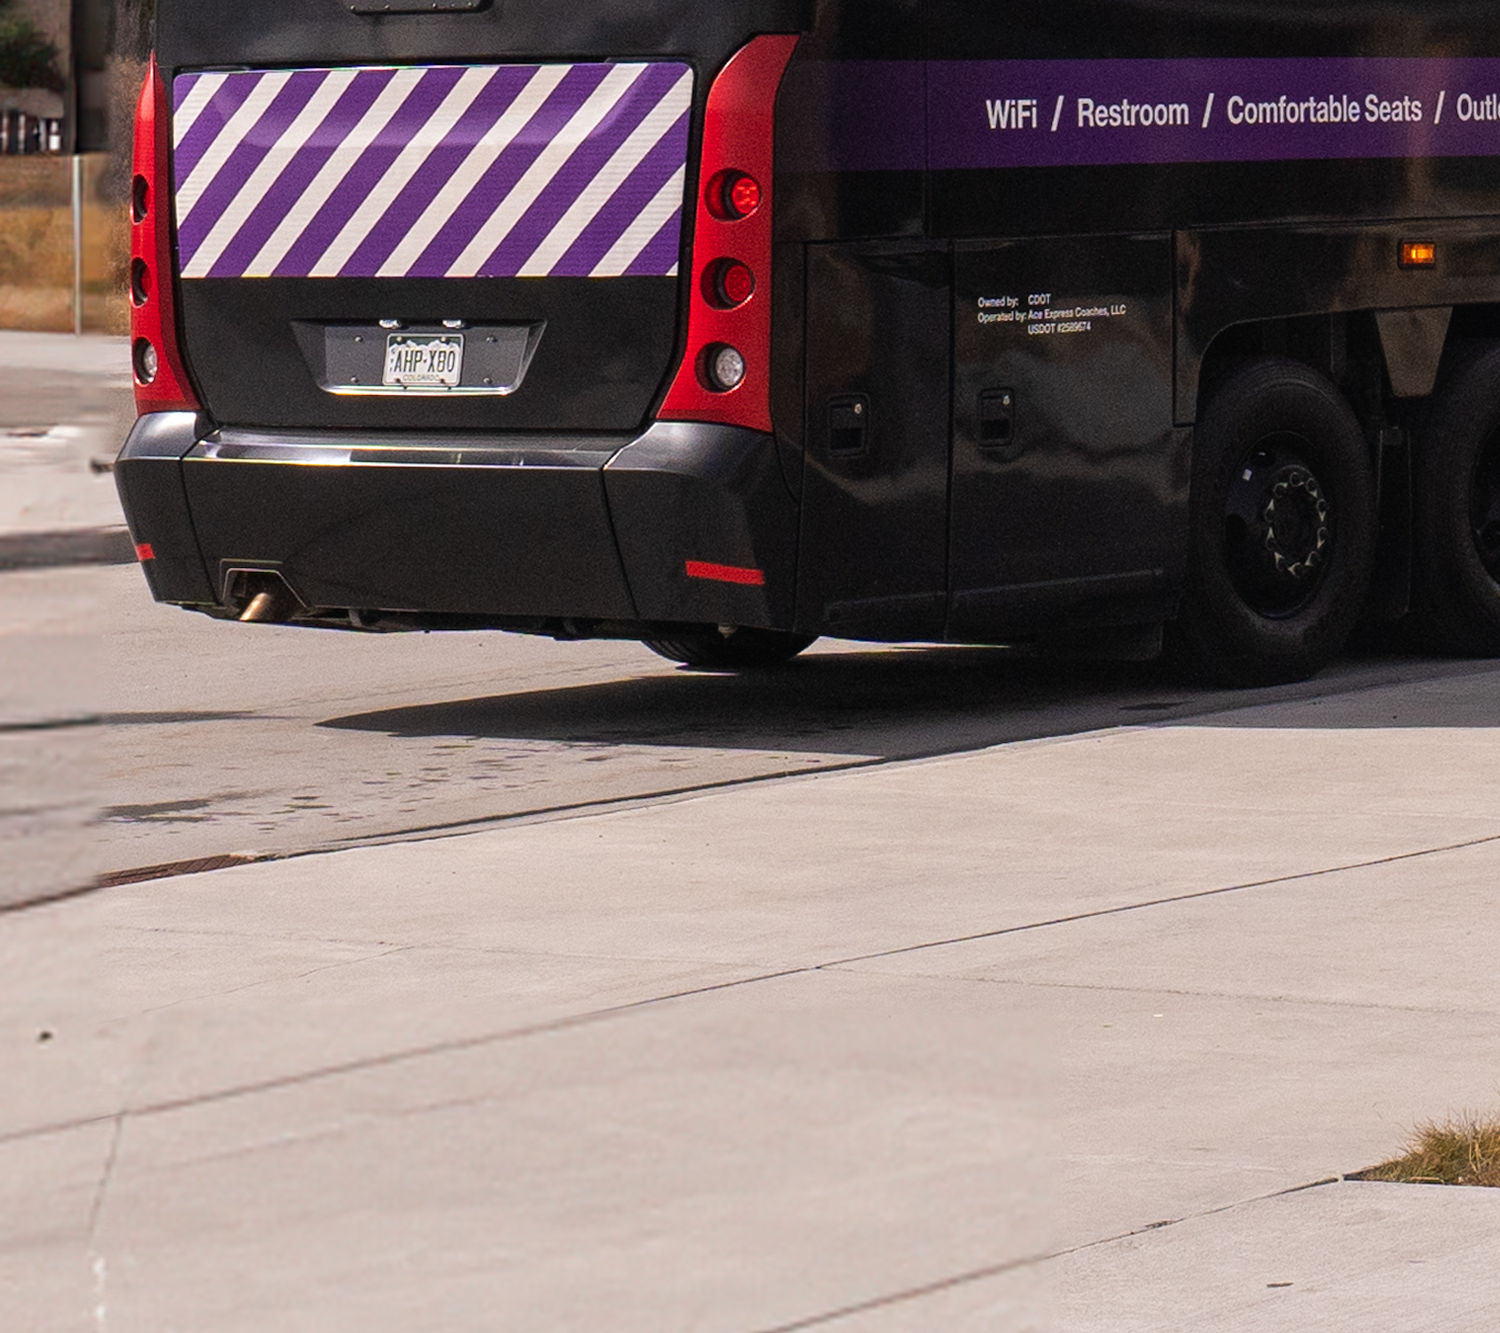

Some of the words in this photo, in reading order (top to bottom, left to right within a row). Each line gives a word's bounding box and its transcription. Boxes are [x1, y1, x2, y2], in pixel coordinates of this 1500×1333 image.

[986, 99, 1038, 130] WiFi
[1077, 97, 1190, 128] Restroom
[1227, 94, 1360, 125] Comfortable
[1365, 93, 1422, 123] Seats
[978, 296, 1005, 308] Owned
[1006, 297, 1019, 309] by:
[978, 311, 1013, 324] Operated
[1028, 309, 1043, 320] Ace
[1044, 307, 1074, 320] Express
[1075, 306, 1109, 317] Coaches,
[1111, 304, 1127, 315] LLC
[1028, 323, 1055, 335] USDOT
